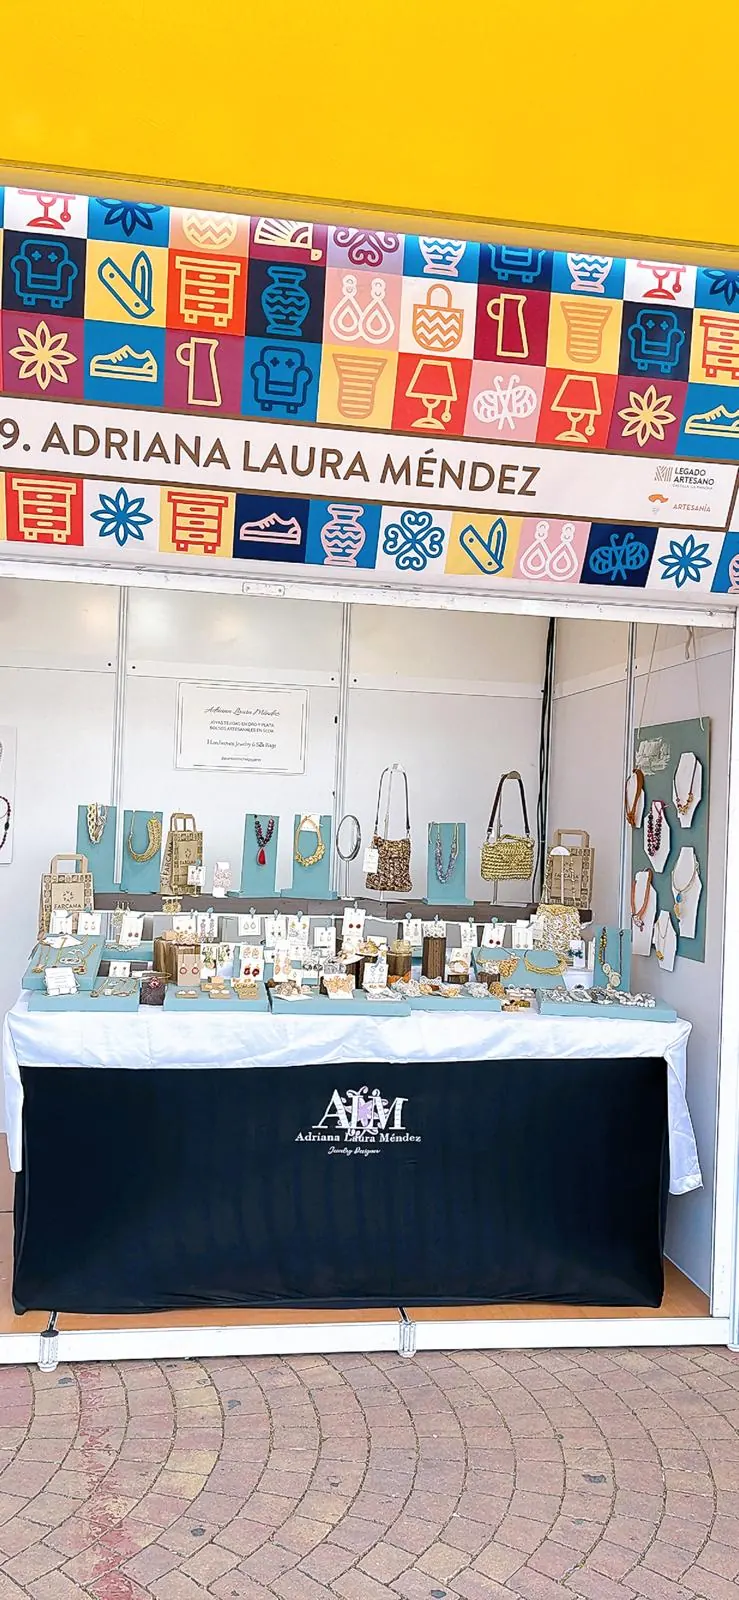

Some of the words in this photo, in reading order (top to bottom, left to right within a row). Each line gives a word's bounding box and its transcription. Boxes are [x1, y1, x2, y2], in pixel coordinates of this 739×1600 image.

[0, 417, 31, 452] 9.
[40, 421, 231, 470] ADRIANA
[242, 440, 370, 482] LAURA
[379, 447, 541, 497] MÉNDEZ
[674, 467, 706, 476] LEGADO
[673, 476, 715, 485] ARTESANO
[672, 504, 711, 512] ARTESANÍA
[295, 1132, 340, 1142] Adriana
[344, 1133, 376, 1143] Laura
[379, 1133, 422, 1143] Méndez
